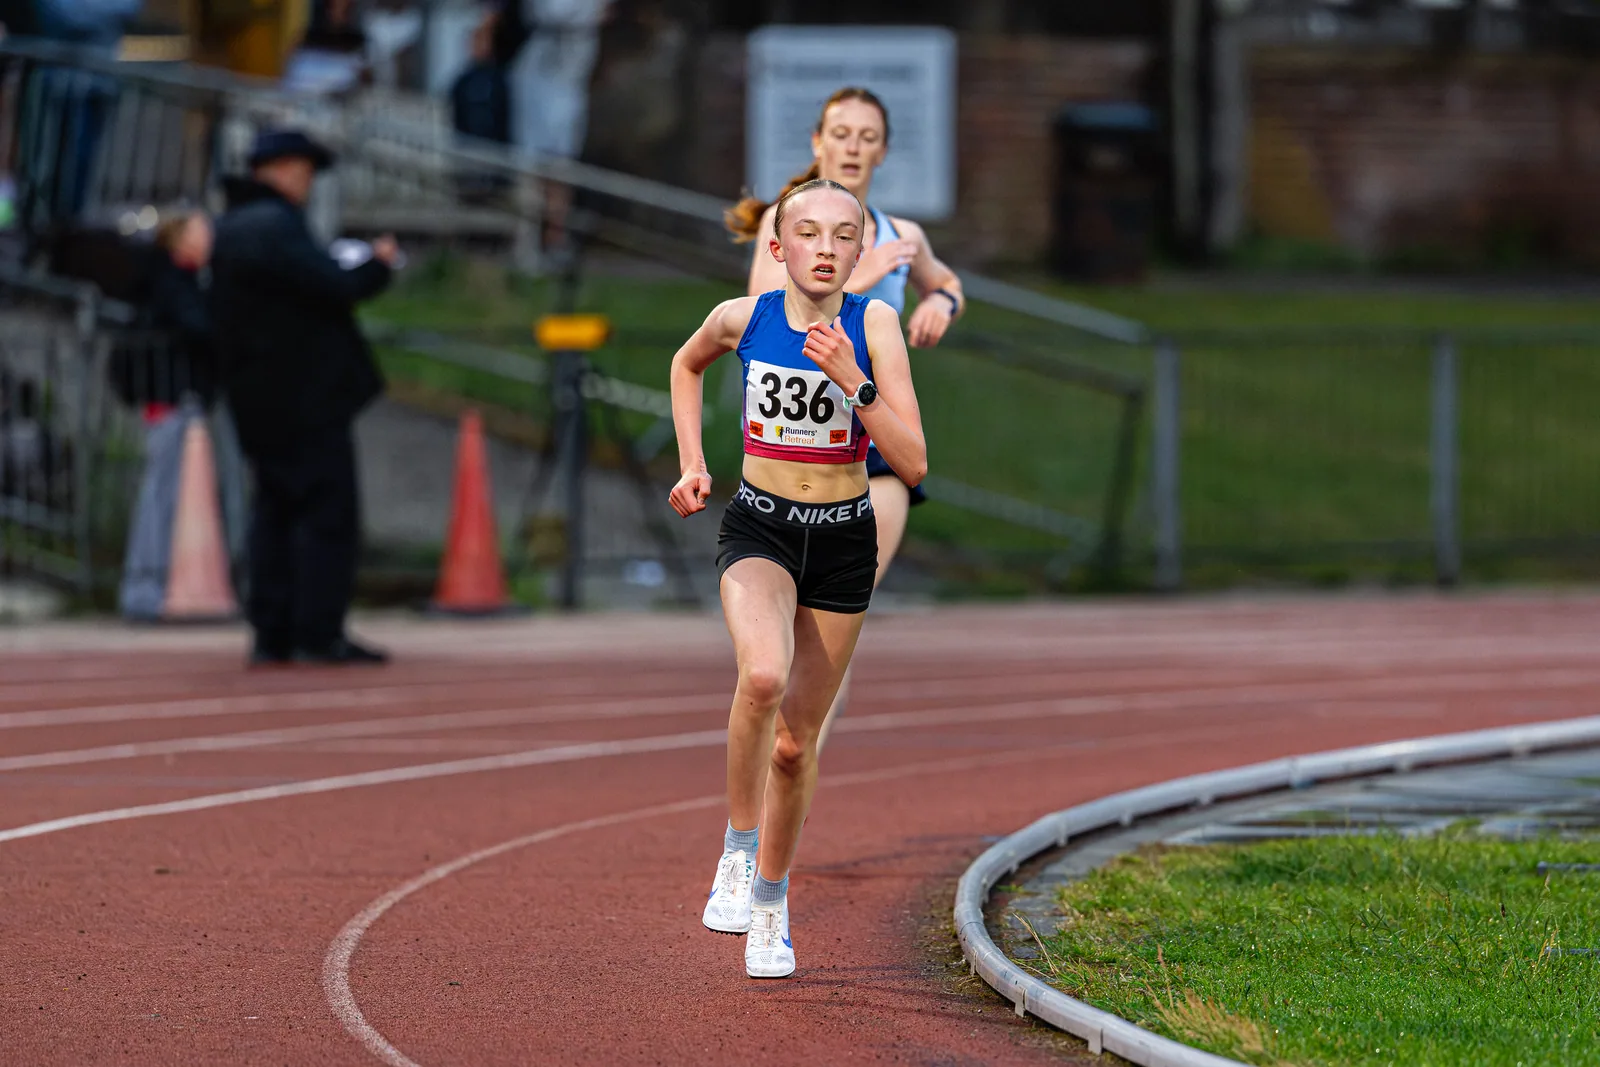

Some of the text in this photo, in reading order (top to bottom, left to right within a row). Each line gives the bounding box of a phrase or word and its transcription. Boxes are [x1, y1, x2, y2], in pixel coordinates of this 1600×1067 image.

[758, 372, 834, 424] 336
[784, 435, 815, 445] Retreat
[787, 504, 853, 524] NIKE
